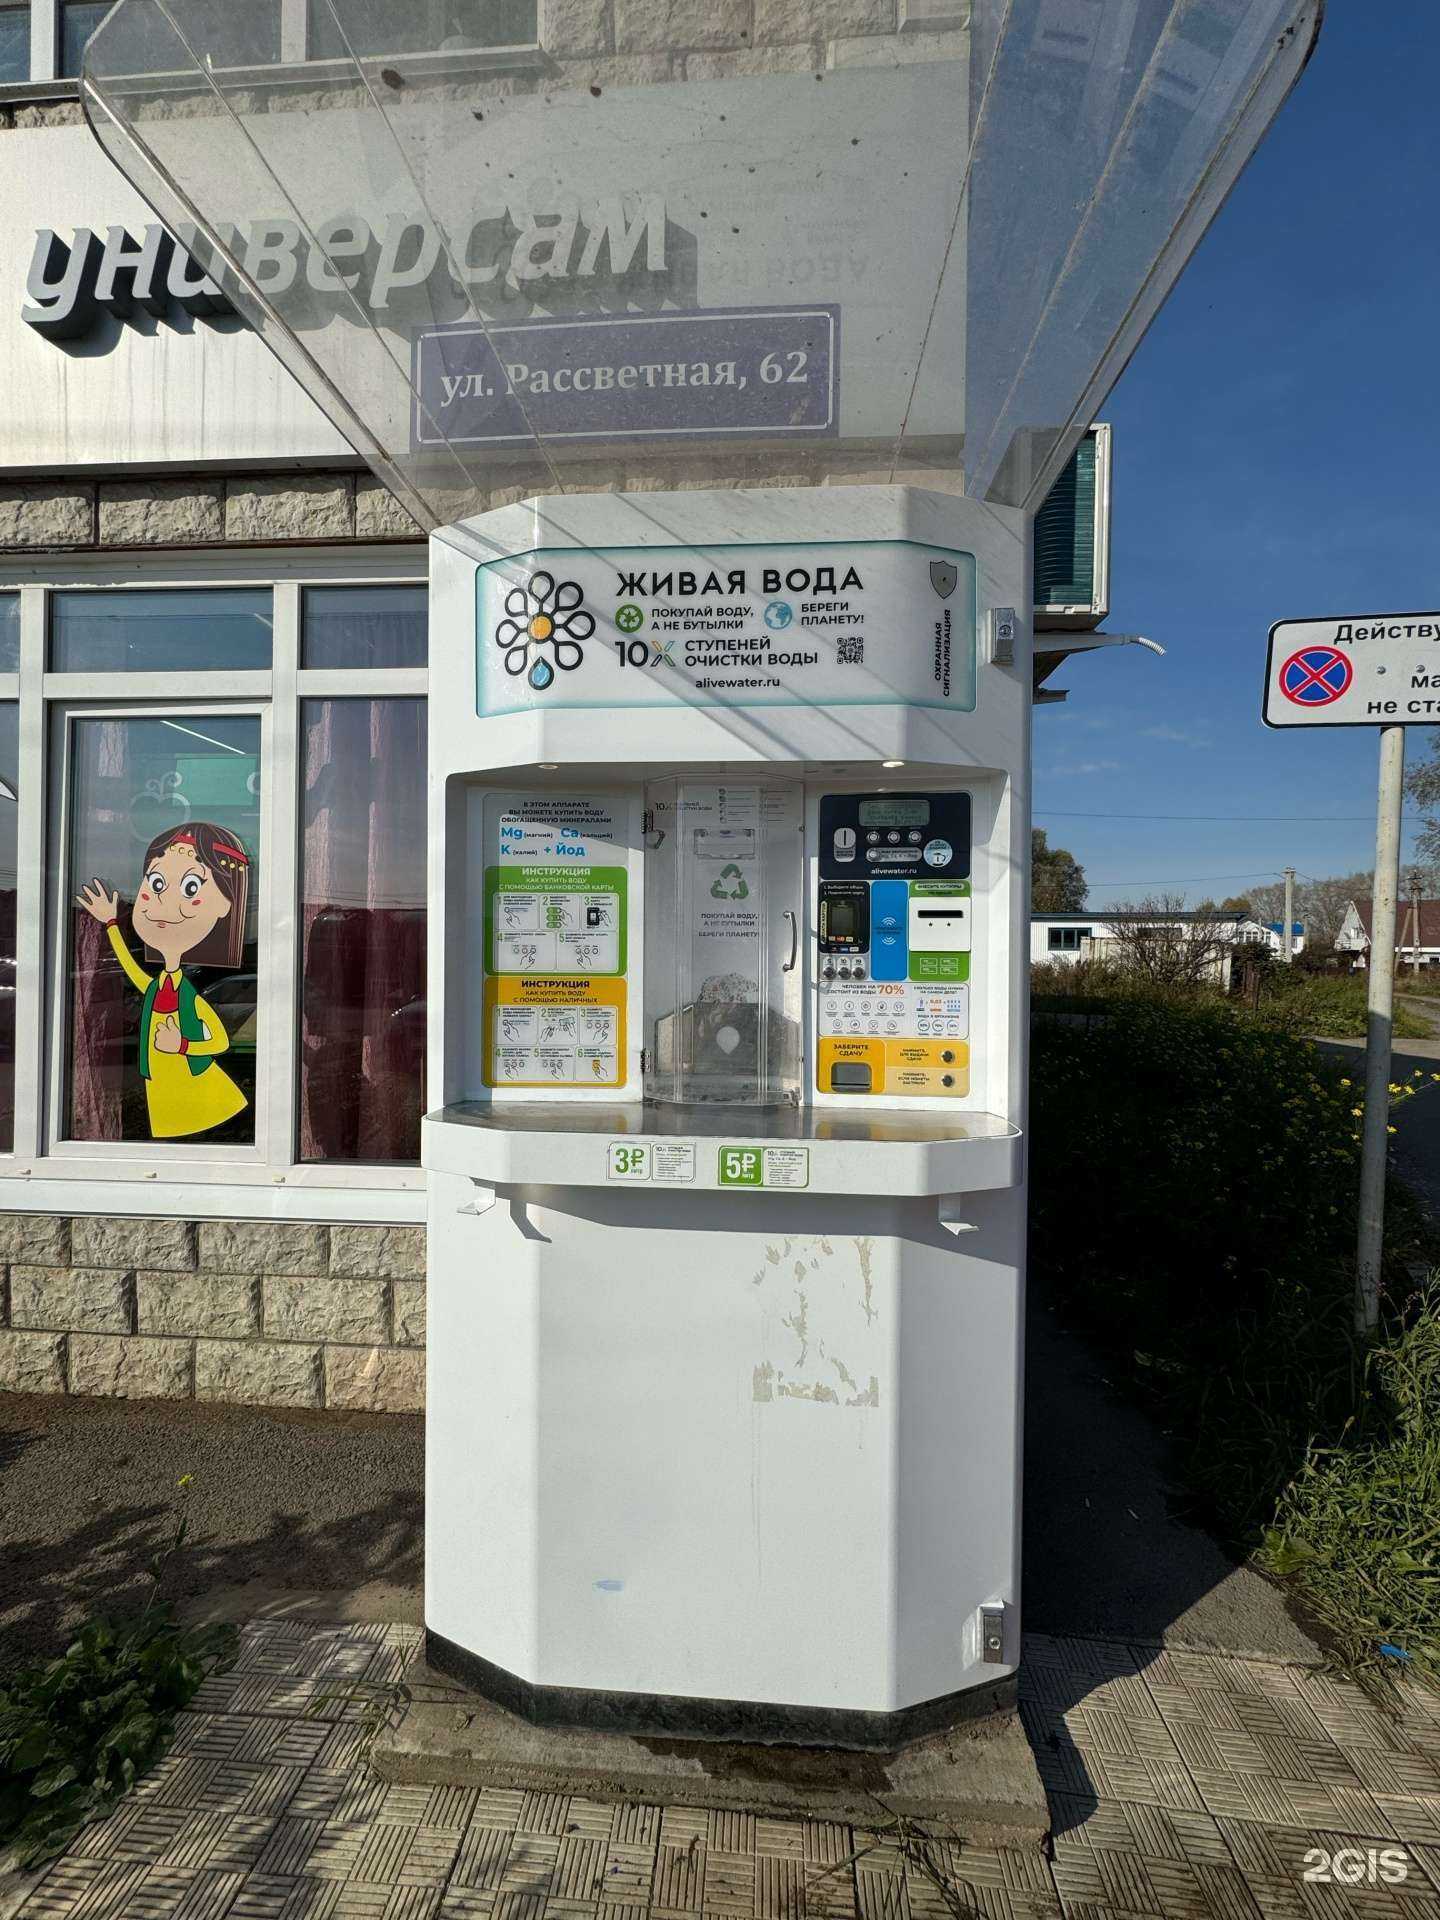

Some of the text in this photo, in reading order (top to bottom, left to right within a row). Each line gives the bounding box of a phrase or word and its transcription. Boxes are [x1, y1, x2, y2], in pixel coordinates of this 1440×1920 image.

[21, 193, 670, 327] универсам
[440, 351, 809, 407] ул. Рассветная, 62
[616, 566, 864, 597] ЖИВАЯ ВОДА
[651, 605, 754, 619] ПОКУПАЙ ВОДУ,
[801, 602, 849, 613] БЕРЕГИ
[651, 618, 744, 631] А НЕ БУТЫЛКИ
[801, 614, 865, 626] ПЛАНЕТУ!
[685, 636, 771, 652] СТУПЕНЕЙ
[934, 622, 942, 681] ОХРАННАЯ
[943, 608, 952, 696] СИГНАЛИЗАЦИЯ
[685, 652, 819, 667] ОЧИСТКИ ВОДЫ
[695, 676, 780, 689] alivewater.ru
[1367, 700, 1398, 714] не
[501, 827, 523, 840] Mg
[556, 842, 585, 856] Йод
[521, 867, 591, 876] ИНСТРУКЦИЯ
[542, 896, 549, 906] 2
[584, 896, 591, 906] 3
[521, 980, 590, 989] ИНСТРУКЦИЯ
[878, 984, 905, 996] 70%
[541, 1008, 547, 1017] 2
[580, 1008, 587, 1017] 3
[577, 1048, 583, 1058] 6
